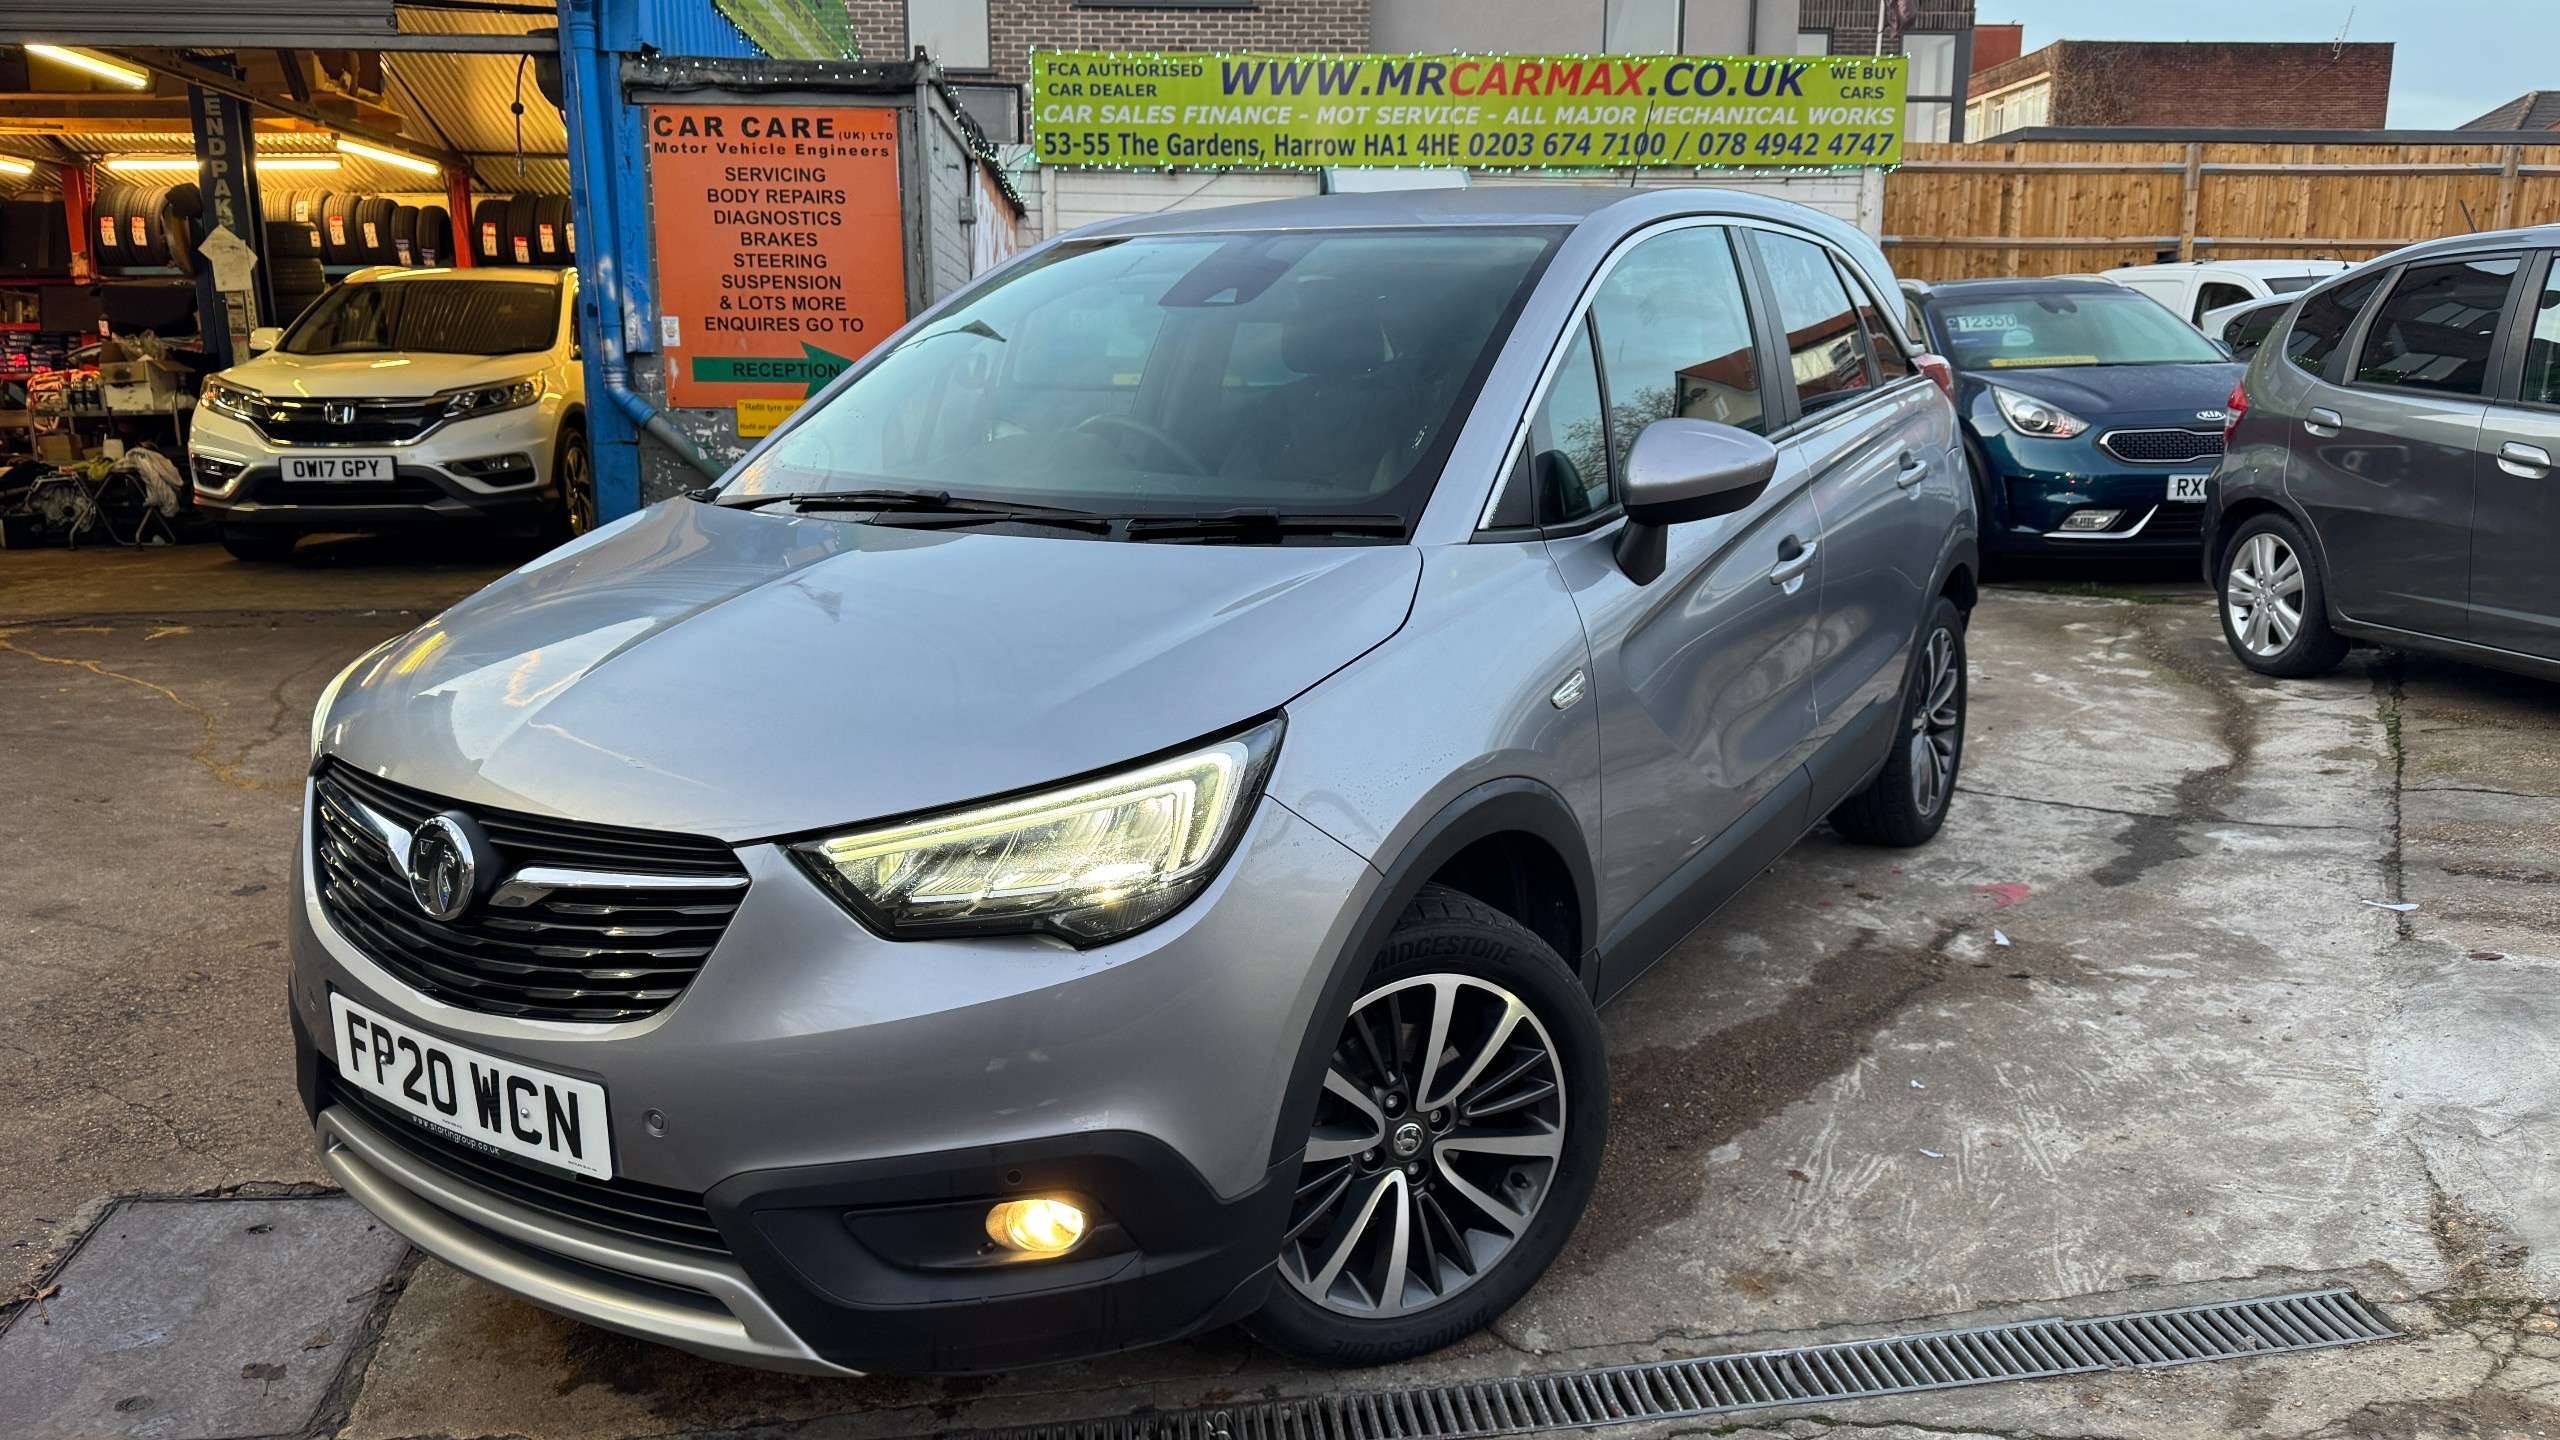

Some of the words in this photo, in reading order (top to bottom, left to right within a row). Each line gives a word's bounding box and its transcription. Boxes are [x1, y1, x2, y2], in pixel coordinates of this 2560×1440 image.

[1048, 63, 1080, 77] FCA
[1087, 63, 1203, 77] AUTHORISED
[1831, 66, 1858, 80] WE
[1863, 66, 1896, 80] BUY
[1221, 62, 1804, 97] WWW.MRCARMAX.CO.UK
[1048, 82, 1085, 97] CAR
[1090, 82, 1157, 98] DEALER
[1840, 86, 1884, 99] CARS
[1043, 105, 1093, 124] CAR
[1099, 105, 1175, 125] SALES
[1182, 105, 1292, 125] FINANCE
[1316, 106, 1371, 125] MOT
[1376, 106, 1478, 125] SERVICE
[1503, 106, 1546, 125] ALL
[1554, 106, 1636, 125] MAJOR
[1645, 106, 1798, 125] MECHANICAL
[1808, 106, 1895, 125] WORKS
[653, 115, 724, 137] CAR
[741, 116, 834, 139] CARE
[838, 131, 866, 142] (UK)
[871, 132, 893, 141] LTD
[654, 143, 707, 154] Motor
[716, 143, 786, 155] Vehicle
[795, 143, 889, 158] Engineers
[1044, 133, 1110, 156] 53-55
[1118, 133, 1159, 156] The
[1167, 133, 1266, 160] Gardens,
[1275, 133, 1355, 157] Harrow
[1365, 133, 1408, 156] HA1
[1417, 133, 1459, 156] 4HE
[1469, 133, 1533, 156] 0203
[1543, 133, 1591, 156] 674
[1601, 133, 1666, 156] 7100
[1674, 133, 1689, 160] /
[1699, 133, 1746, 156] 078
[1755, 133, 1818, 156] 4942
[1828, 133, 1894, 156] 4747
[725, 167, 826, 182] SERVICING
[707, 188, 760, 203] BODY
[766, 189, 846, 204] REPAIRS
[714, 210, 842, 225] DIAGNOSTICS
[740, 232, 817, 247] BRAKES
[733, 253, 827, 268] STEERING
[721, 274, 841, 290] SUSPENSION
[720, 295, 732, 310] &
[738, 296, 786, 310] LOTS
[792, 296, 847, 311] MORE
[704, 316, 800, 332] ENQUIRES
[806, 317, 834, 332] GO
[841, 317, 864, 333] TO
[733, 361, 842, 378] RECEPTION
[293, 460, 335, 478] OW17
[341, 460, 379, 478] GPY
[1372, 935, 1516, 969] RIDGESTONE
[346, 1008, 458, 1116] FP20
[470, 1061, 583, 1160] WCN
